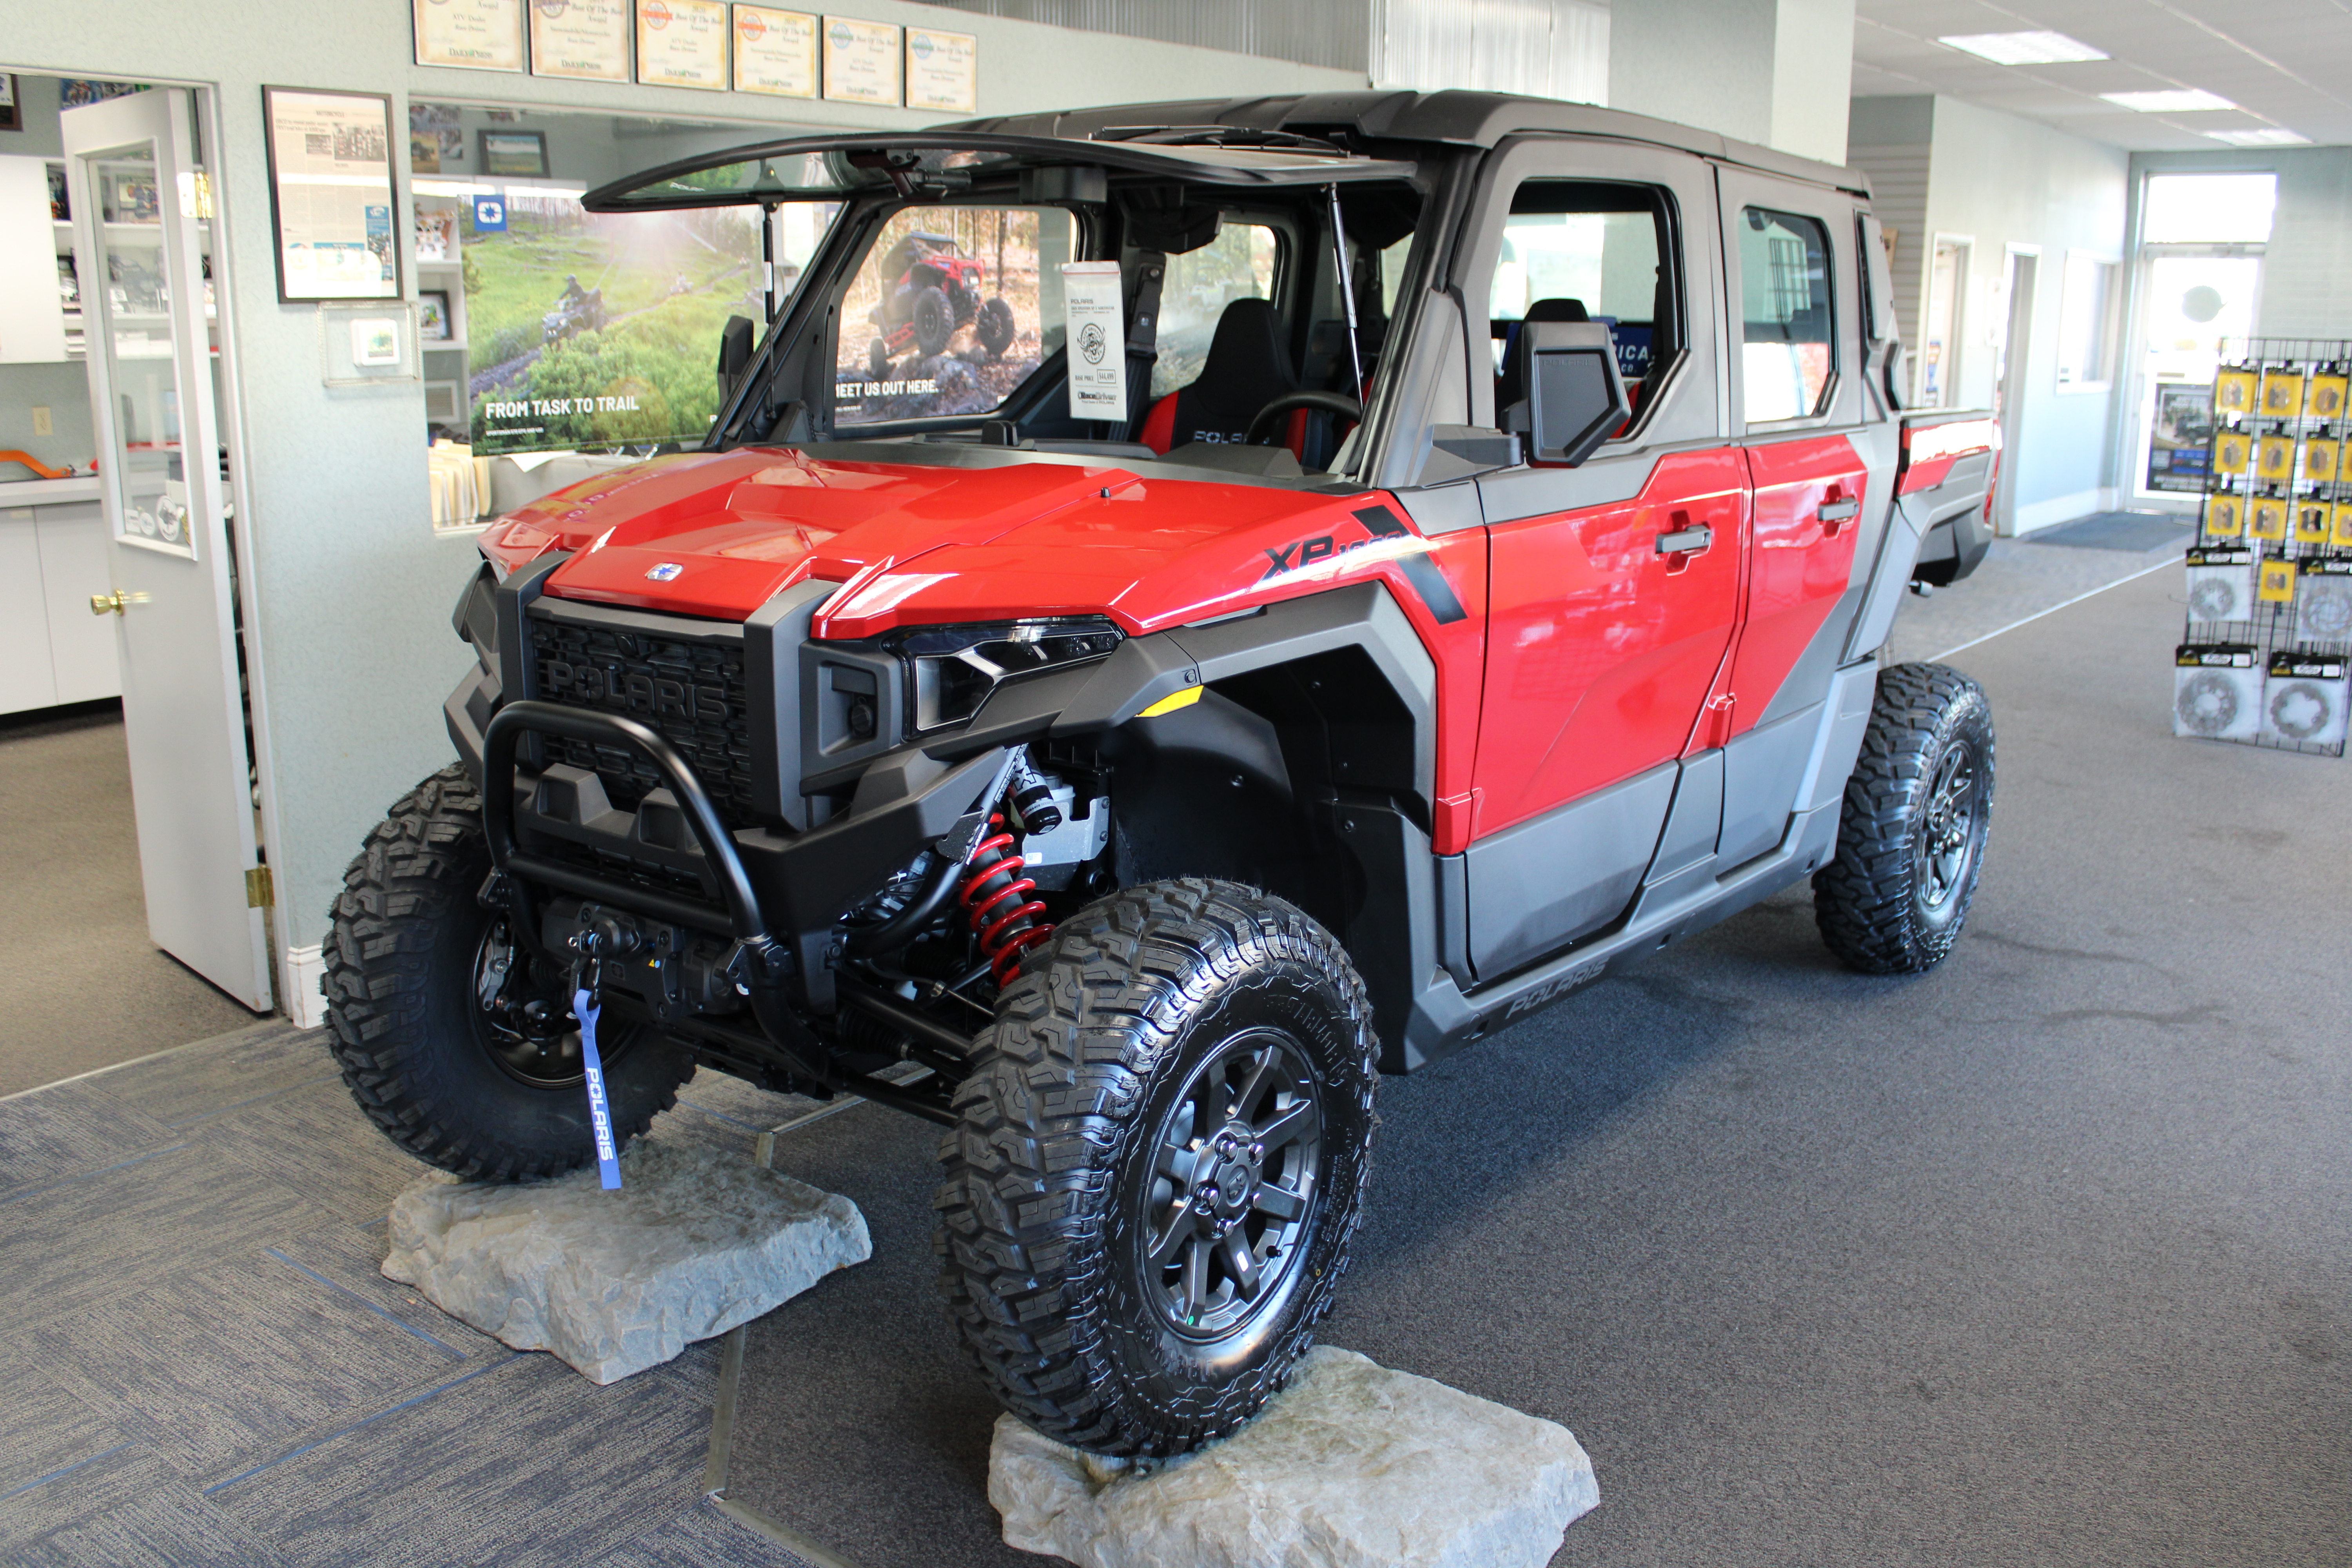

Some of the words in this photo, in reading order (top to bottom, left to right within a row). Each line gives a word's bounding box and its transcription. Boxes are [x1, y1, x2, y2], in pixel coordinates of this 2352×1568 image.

[1543, 358, 1596, 367] POLARIS
[485, 400, 529, 420] FROM
[531, 398, 572, 417] TASK
[574, 397, 594, 414] TO
[596, 395, 640, 412] TRAIL
[864, 381, 881, 397] US
[882, 380, 906, 397] OUT
[906, 378, 939, 395] HERE.
[1194, 430, 1270, 444] POLA
[1256, 535, 1334, 584] XP
[548, 660, 728, 722] POLARIS
[966, 822, 988, 866] POLARIS
[1505, 957, 1610, 1019] POLARIS
[586, 1067, 614, 1161] POLARIS
